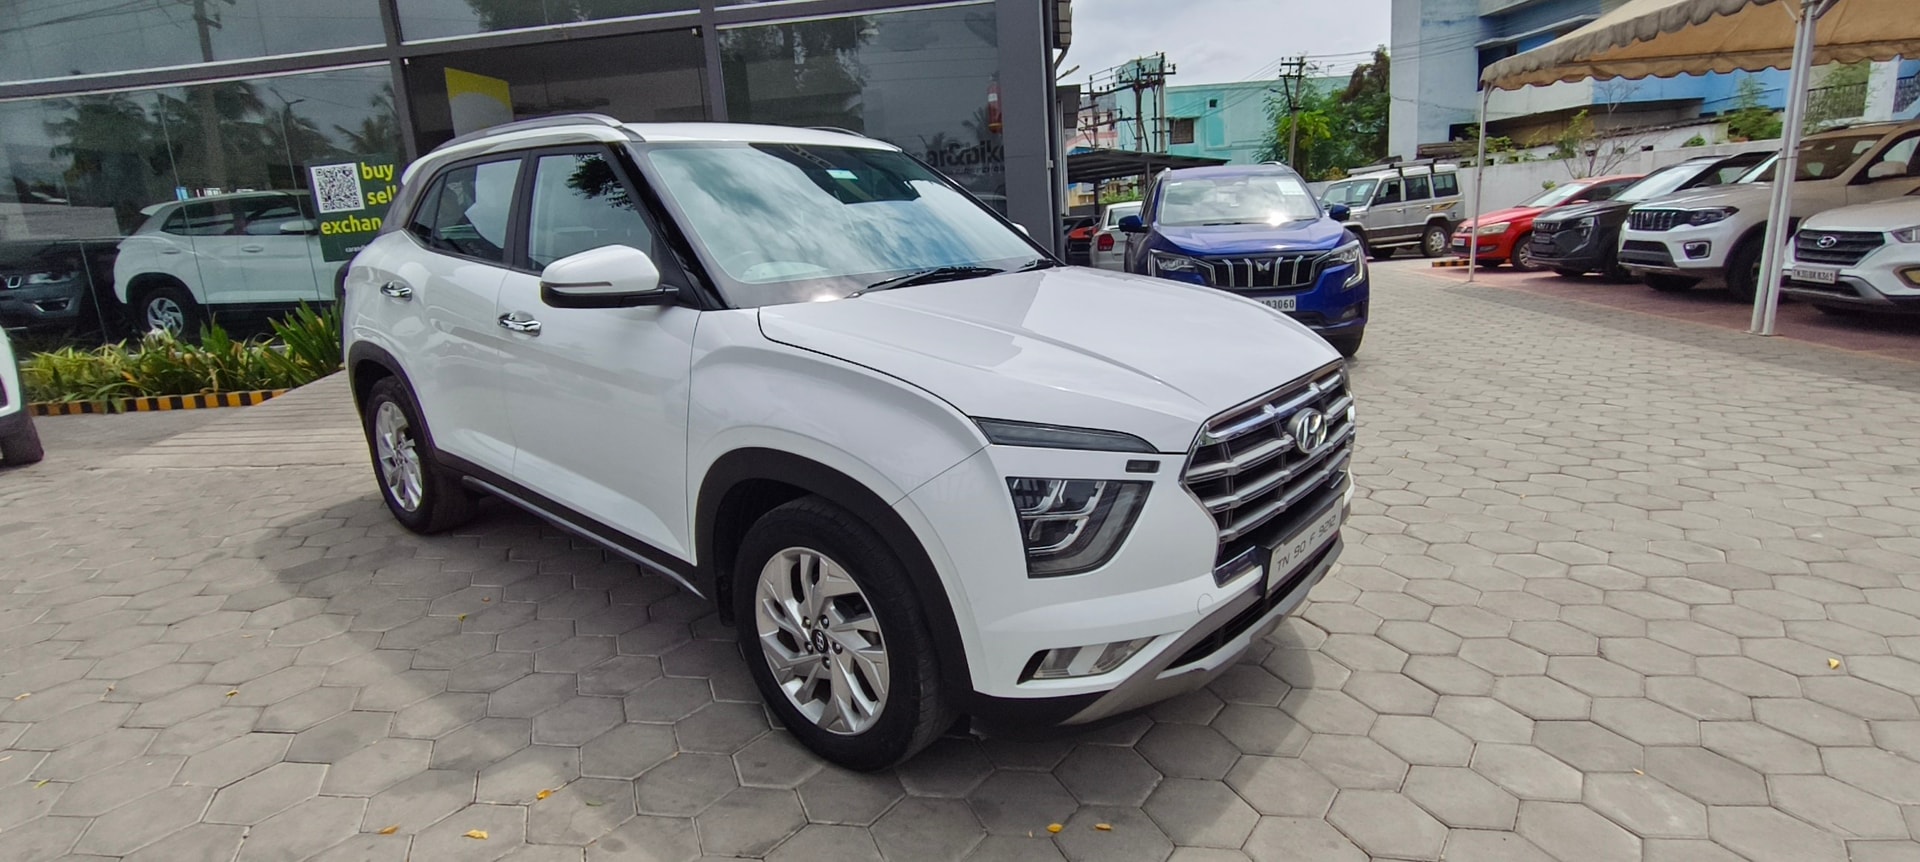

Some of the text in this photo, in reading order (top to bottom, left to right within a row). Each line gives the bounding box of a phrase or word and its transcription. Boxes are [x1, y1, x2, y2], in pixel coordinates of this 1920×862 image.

[361, 162, 394, 181] buy
[1277, 554, 1290, 570] TN
[1294, 541, 1306, 558] 90
[1310, 532, 1316, 544] F
